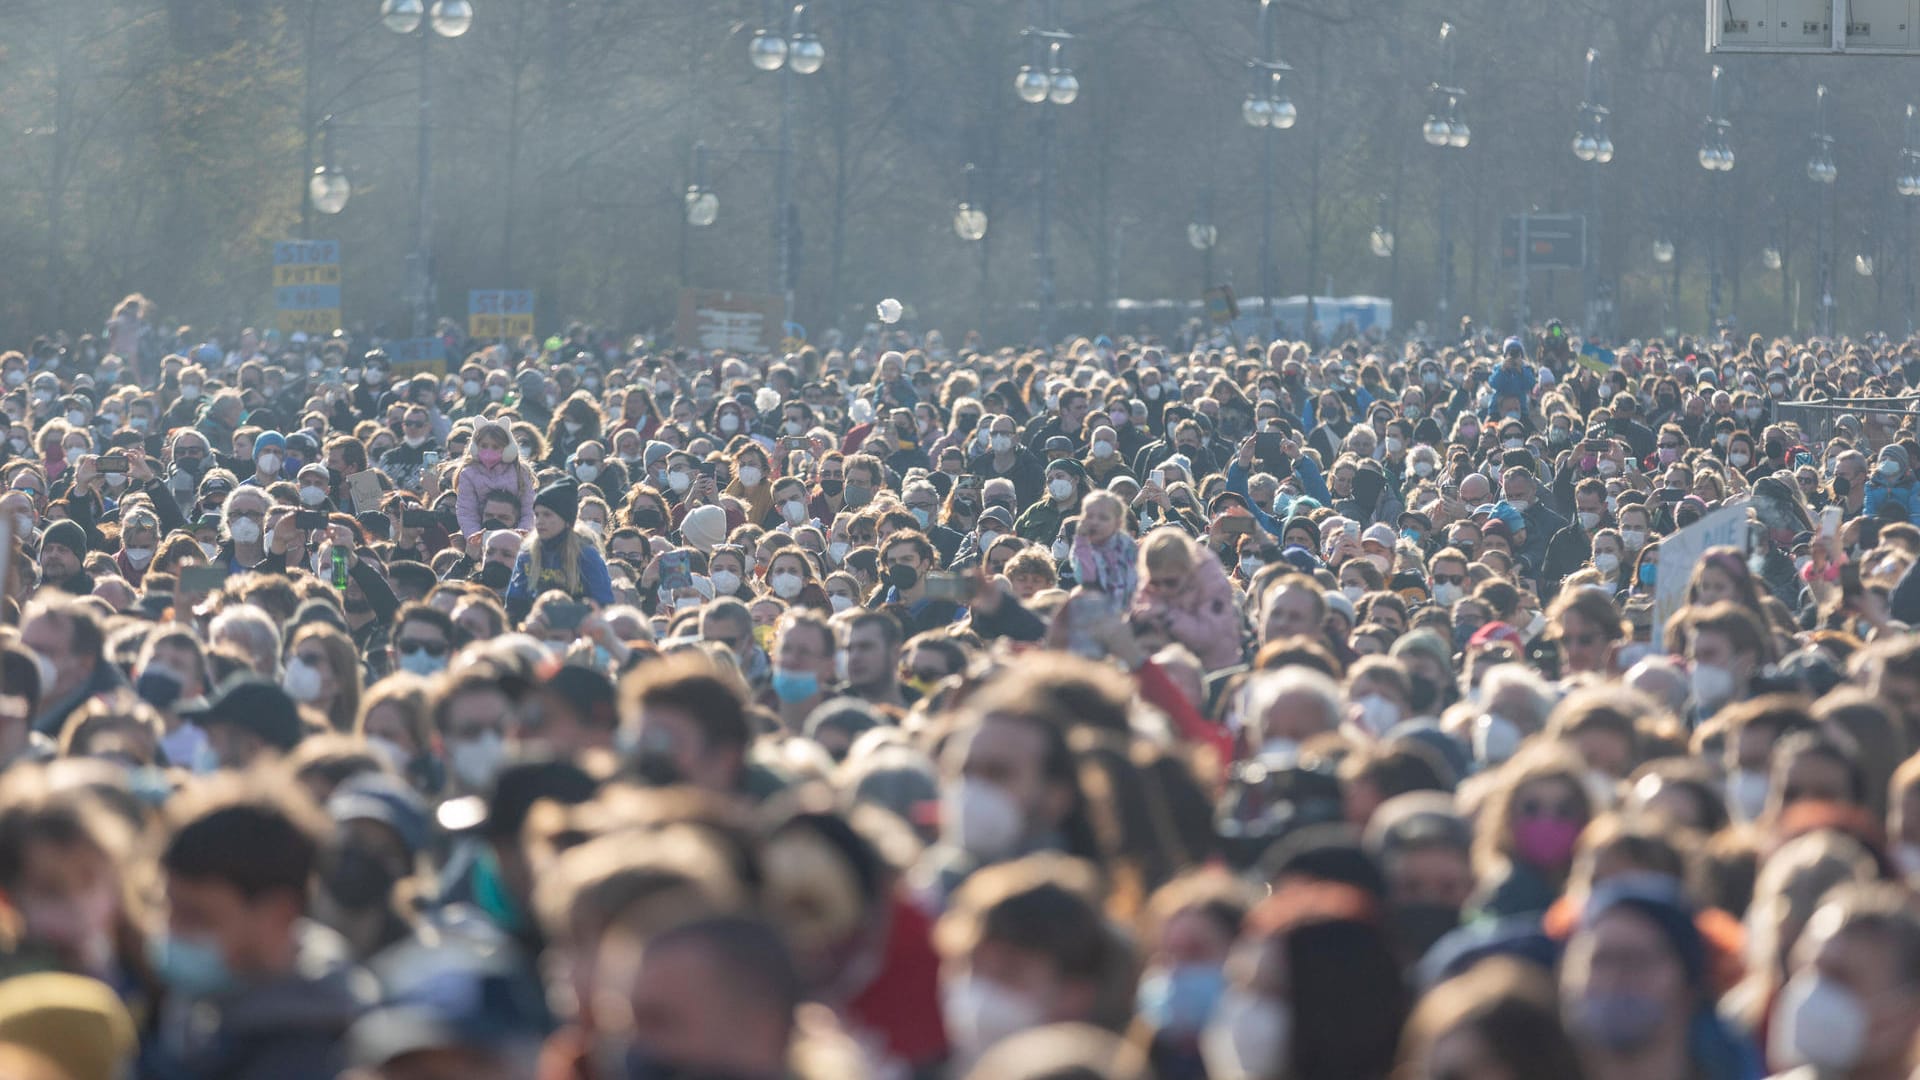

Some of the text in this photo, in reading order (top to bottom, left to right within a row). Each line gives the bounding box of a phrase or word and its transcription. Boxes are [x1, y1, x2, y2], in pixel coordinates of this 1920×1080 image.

[279, 244, 334, 263] STOP
[281, 267, 338, 283] PUTIN
[476, 295, 528, 312] STOP
